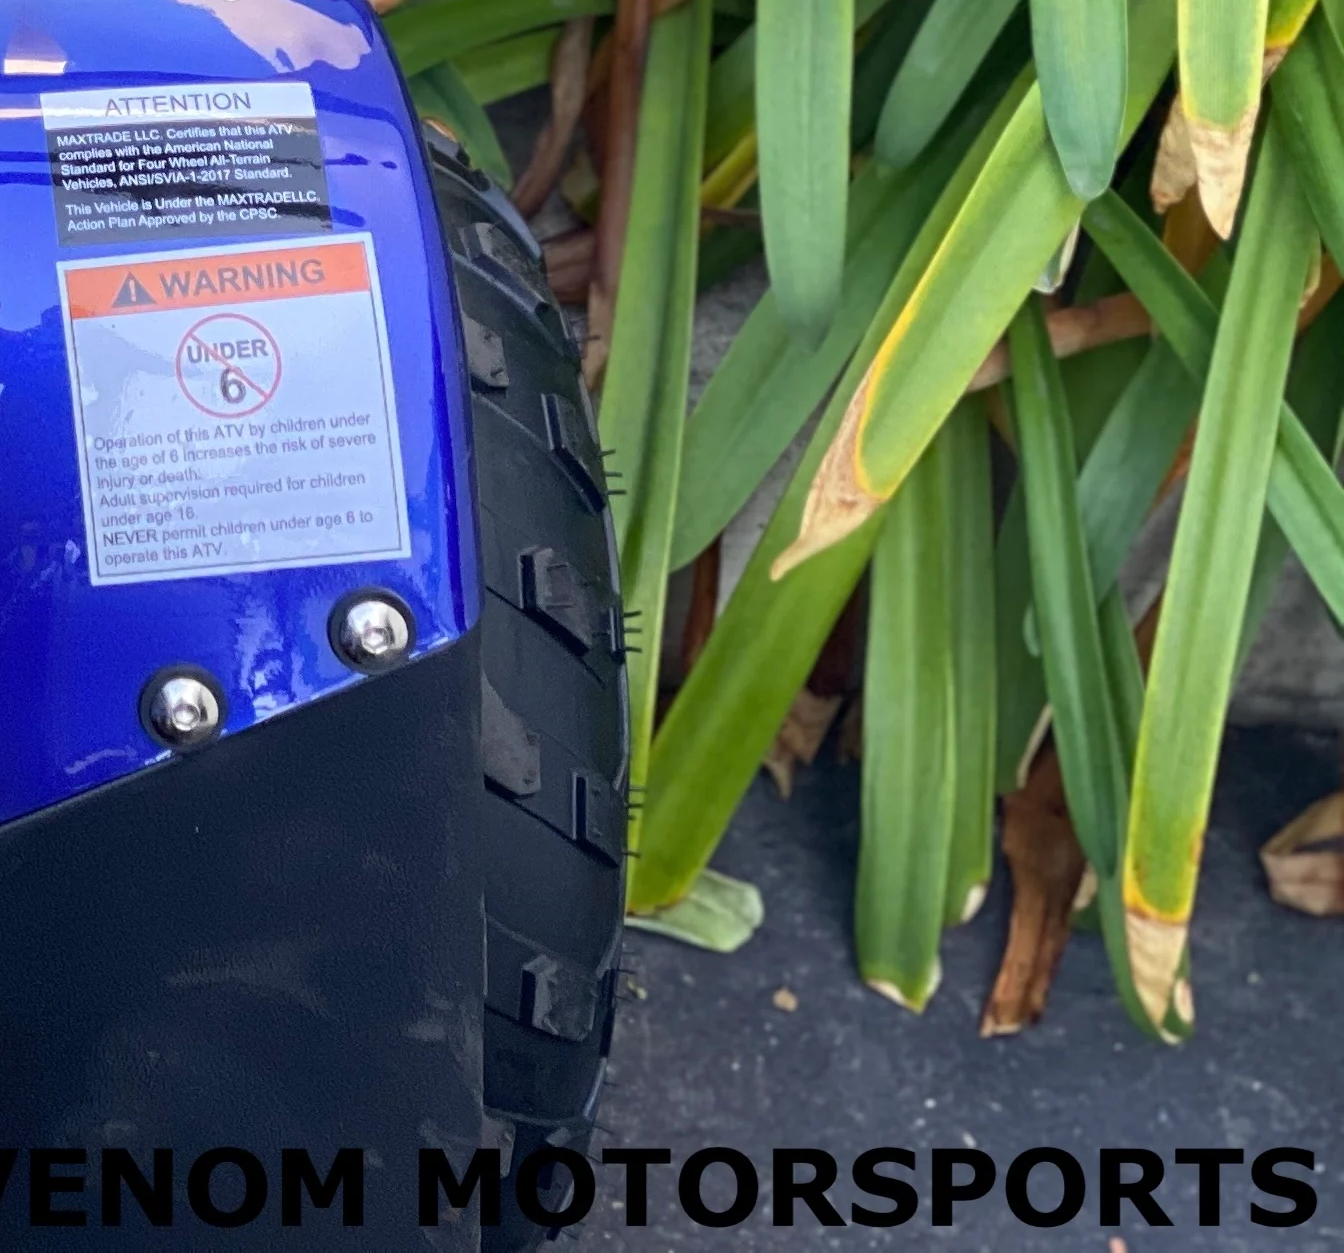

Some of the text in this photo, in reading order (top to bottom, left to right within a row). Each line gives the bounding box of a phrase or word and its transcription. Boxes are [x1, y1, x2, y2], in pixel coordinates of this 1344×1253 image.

[106, 92, 251, 115] ATTENTION
[56, 131, 131, 146] MAXTRADE
[166, 127, 216, 139] Certifies
[218, 125, 242, 136] that
[243, 124, 266, 136] this
[267, 123, 294, 135] ATV
[59, 139, 273, 160] complies with American National
[60, 153, 270, 175] Standard for Four Wheel All-Terrain
[119, 170, 229, 186] ANSI/SVIA-1-2017
[234, 168, 292, 180] Standard.
[65, 203, 91, 215] This
[94, 200, 139, 213] Vehicle
[154, 197, 192, 210] Under
[67, 219, 105, 231] Action
[108, 216, 136, 228] Plan
[138, 212, 196, 227] Approved
[160, 259, 325, 297] WARNING
[187, 339, 269, 363] UNDER
[220, 367, 246, 404] 6
